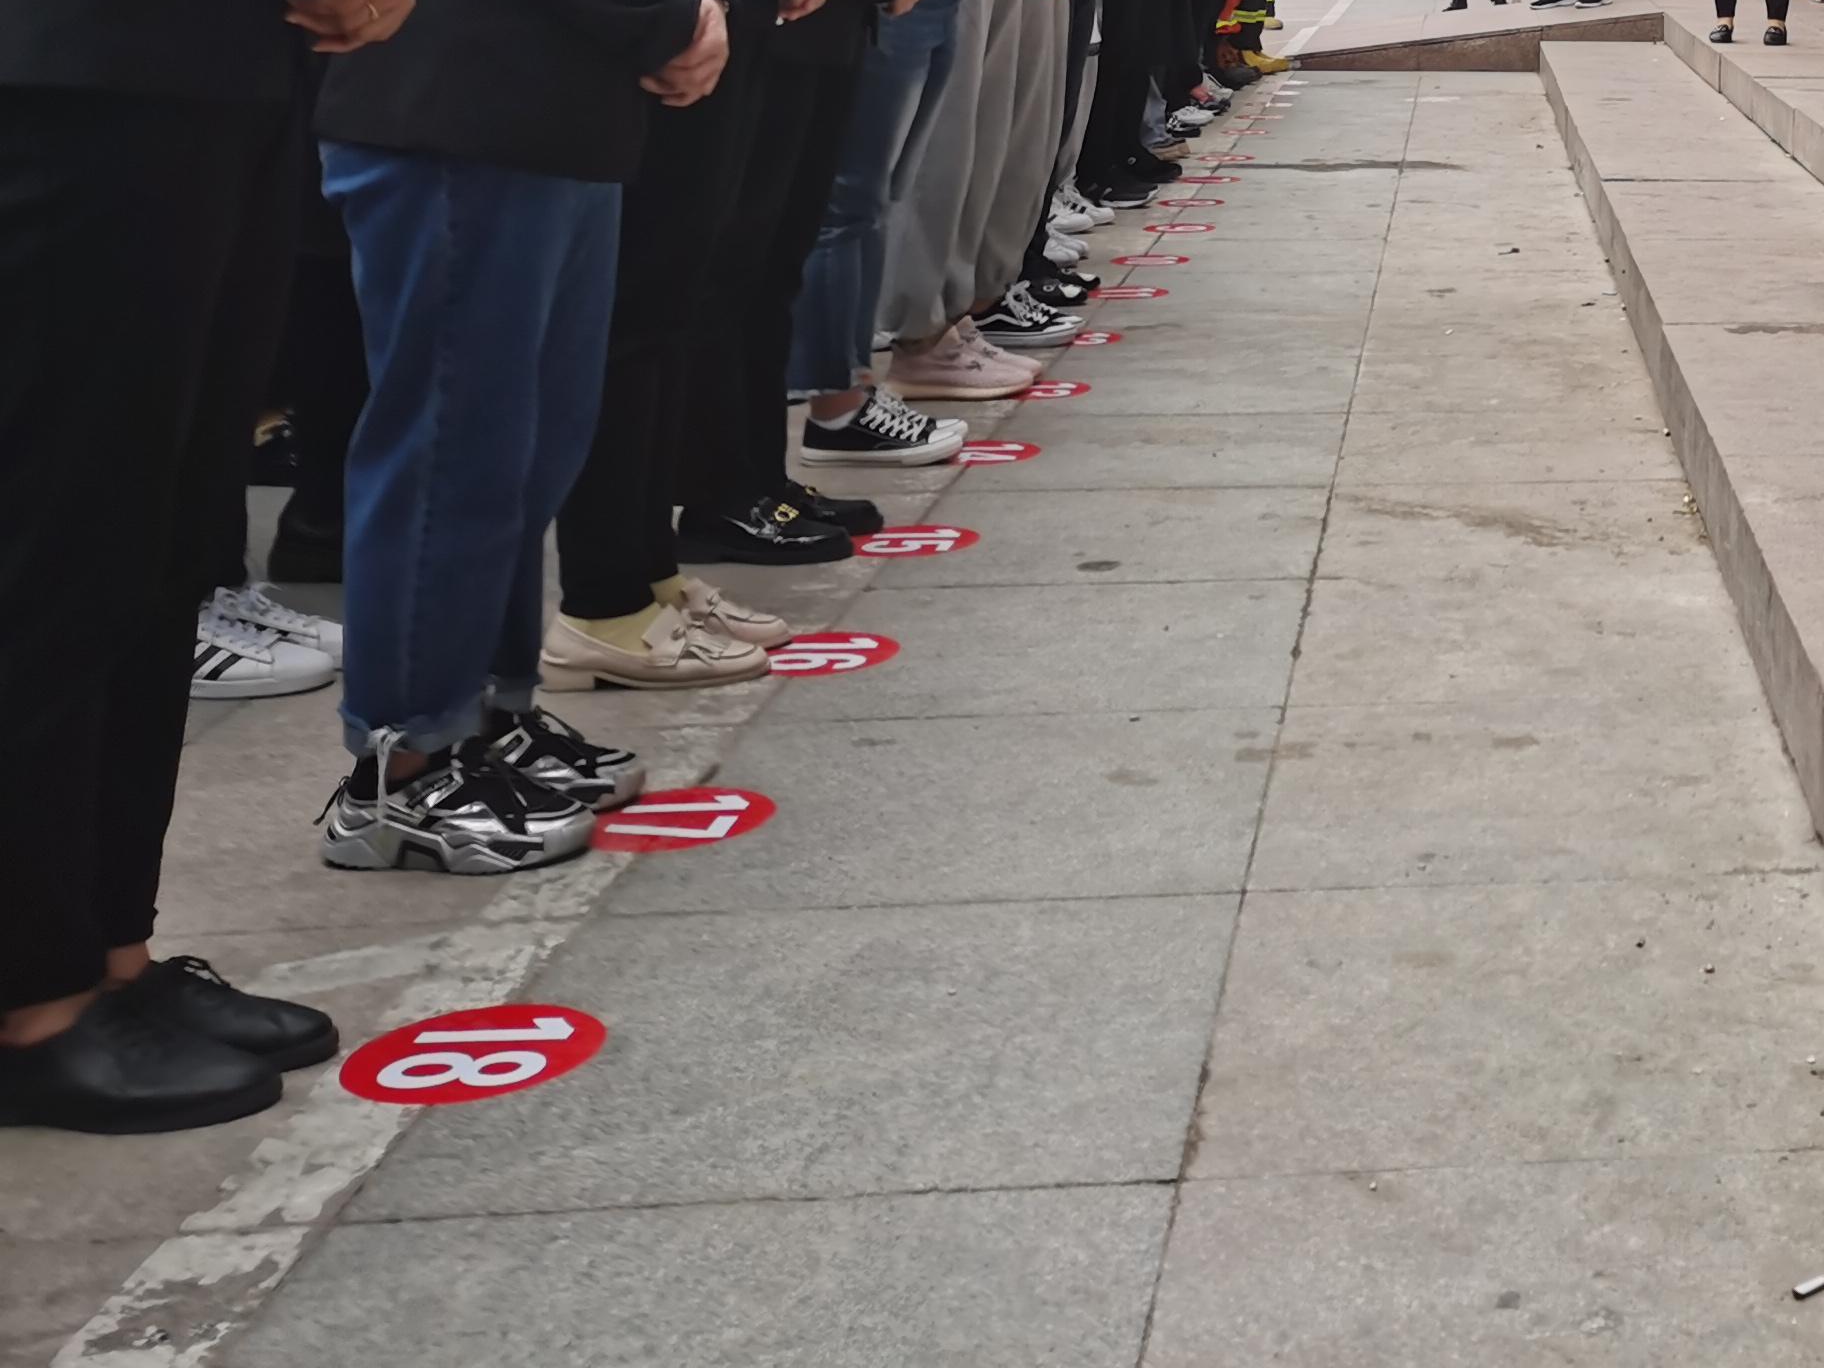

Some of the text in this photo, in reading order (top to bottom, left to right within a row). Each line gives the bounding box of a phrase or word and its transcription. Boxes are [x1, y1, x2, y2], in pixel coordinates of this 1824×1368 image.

[957, 443, 1025, 463] 14
[861, 528, 961, 554] 15
[767, 636, 879, 673] 16
[603, 792, 751, 839] 17
[376, 1016, 576, 1089] 18
